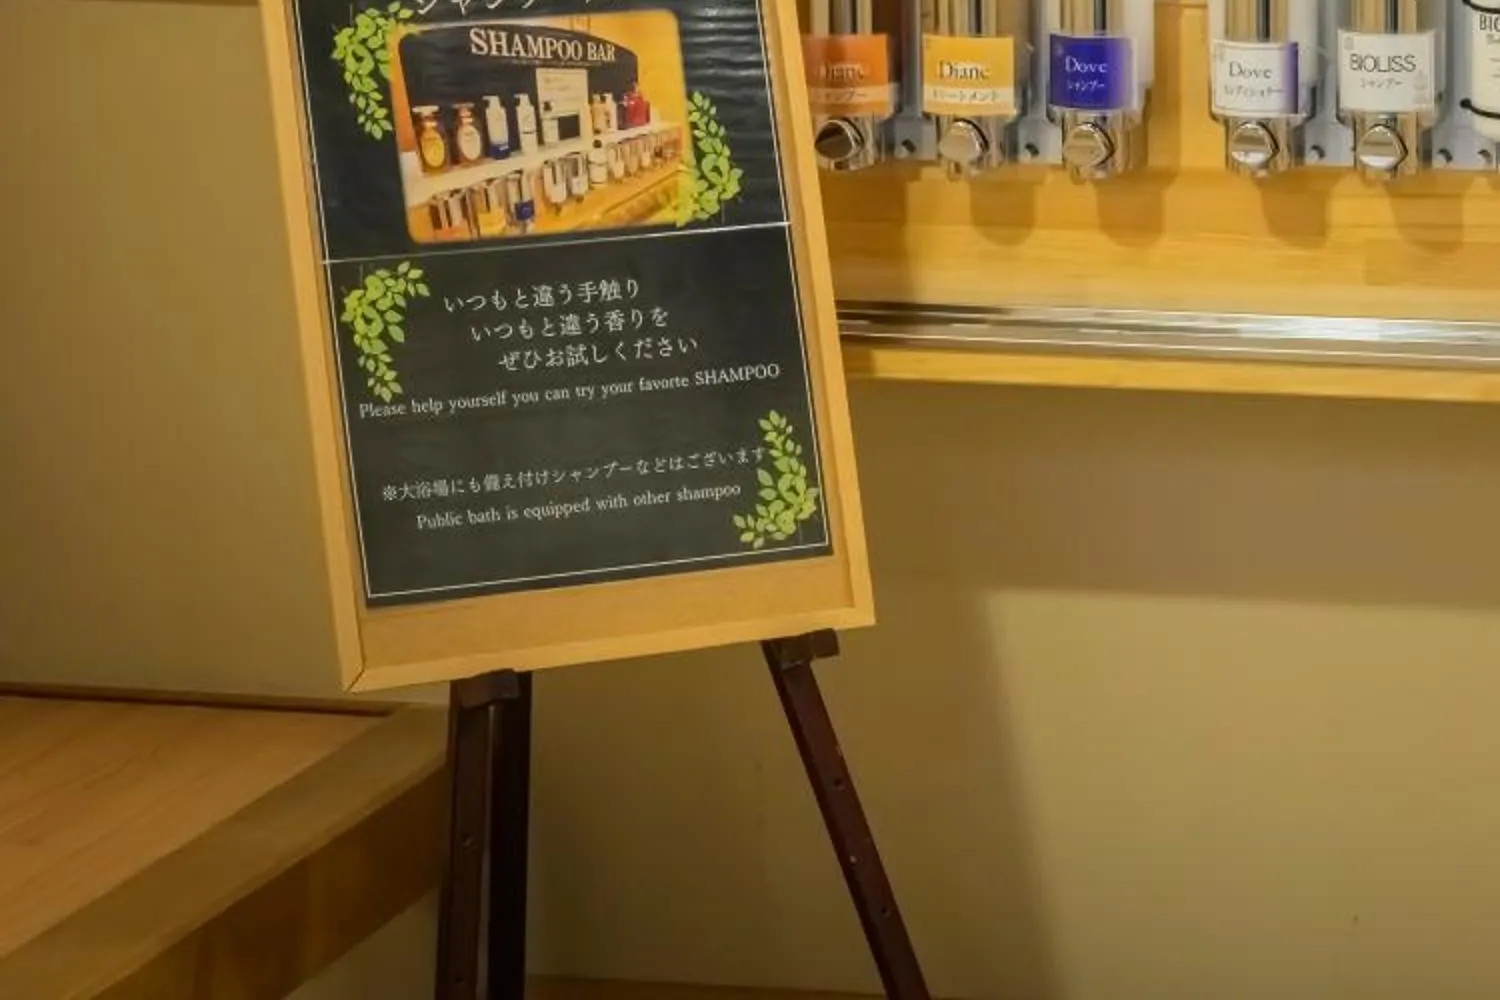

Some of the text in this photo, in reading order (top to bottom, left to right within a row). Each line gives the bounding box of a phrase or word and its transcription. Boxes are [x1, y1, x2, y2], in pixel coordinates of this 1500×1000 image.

[469, 27, 615, 62] SHAMPOO BAR
[938, 61, 991, 81] Diane
[1065, 55, 1108, 74] Dove
[1229, 61, 1273, 80] Dove
[1349, 53, 1416, 73] BIOLISS
[443, 279, 640, 313] いつもと違う手触り
[470, 307, 669, 342] いつもと違う香りを
[498, 336, 698, 371] ぜひお試しください
[359, 402, 407, 419] Please
[411, 397, 443, 415] help
[449, 391, 507, 414] yourself
[511, 391, 539, 407] you
[544, 386, 570, 401] can
[575, 385, 595, 401] try
[600, 380, 633, 399] your
[694, 362, 780, 387] SHAMPOO
[416, 483, 742, 530] Public bath is equipped with other shampoo
